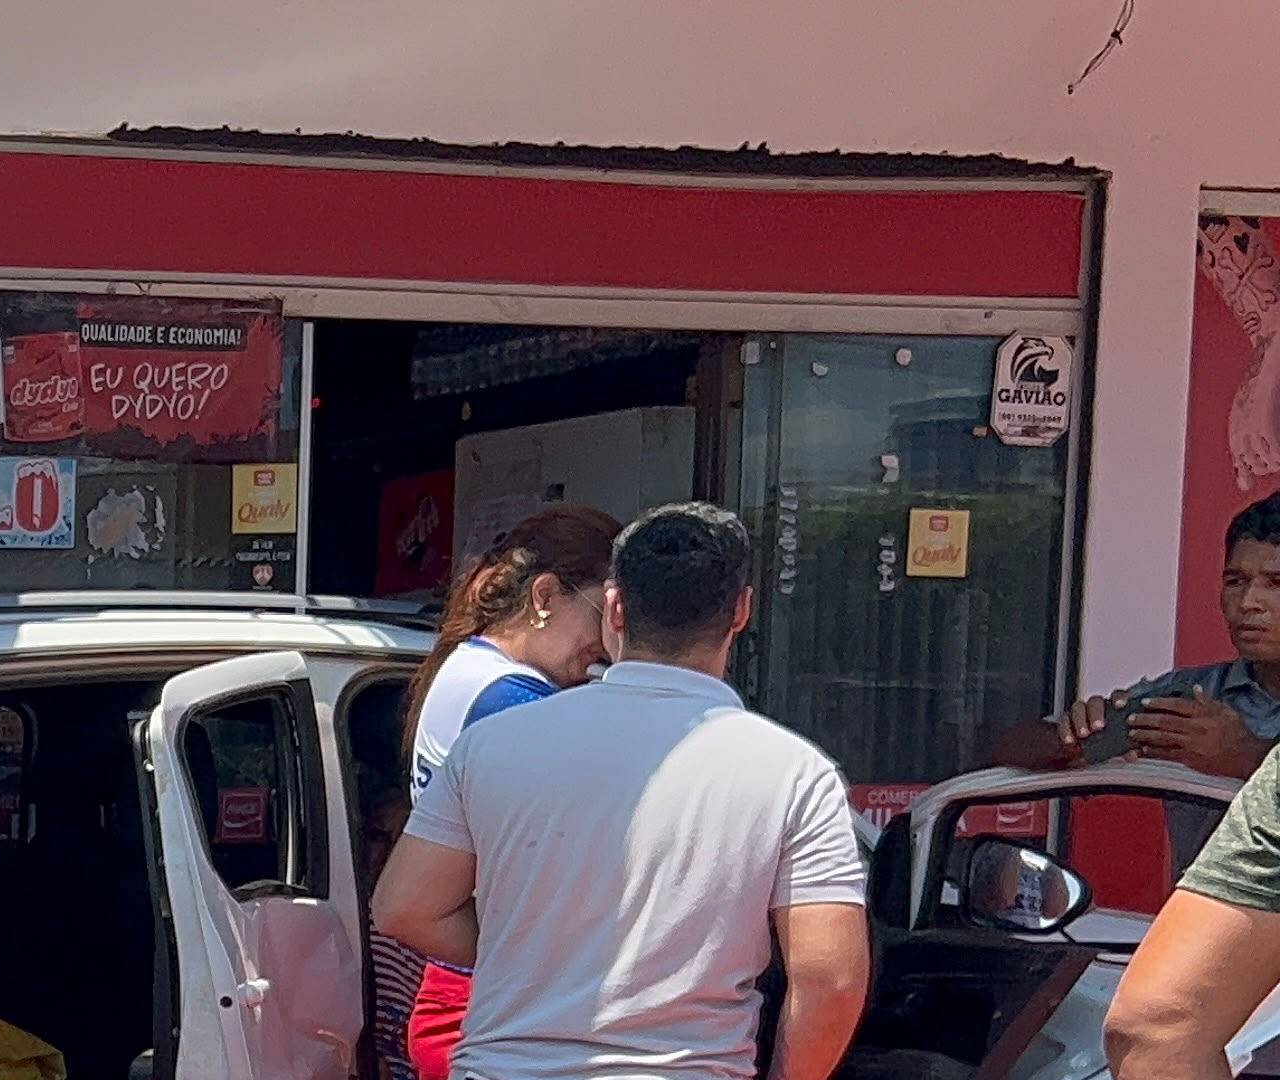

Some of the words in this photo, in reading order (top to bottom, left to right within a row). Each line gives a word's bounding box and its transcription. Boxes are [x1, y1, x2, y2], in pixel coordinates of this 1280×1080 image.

[81, 323, 153, 344] QUALIDADE
[156, 326, 166, 344] E
[169, 326, 242, 346] ECONOMIA!
[90, 362, 124, 393] EU
[133, 361, 229, 395] QUERO
[111, 388, 211, 420] DYDYO!
